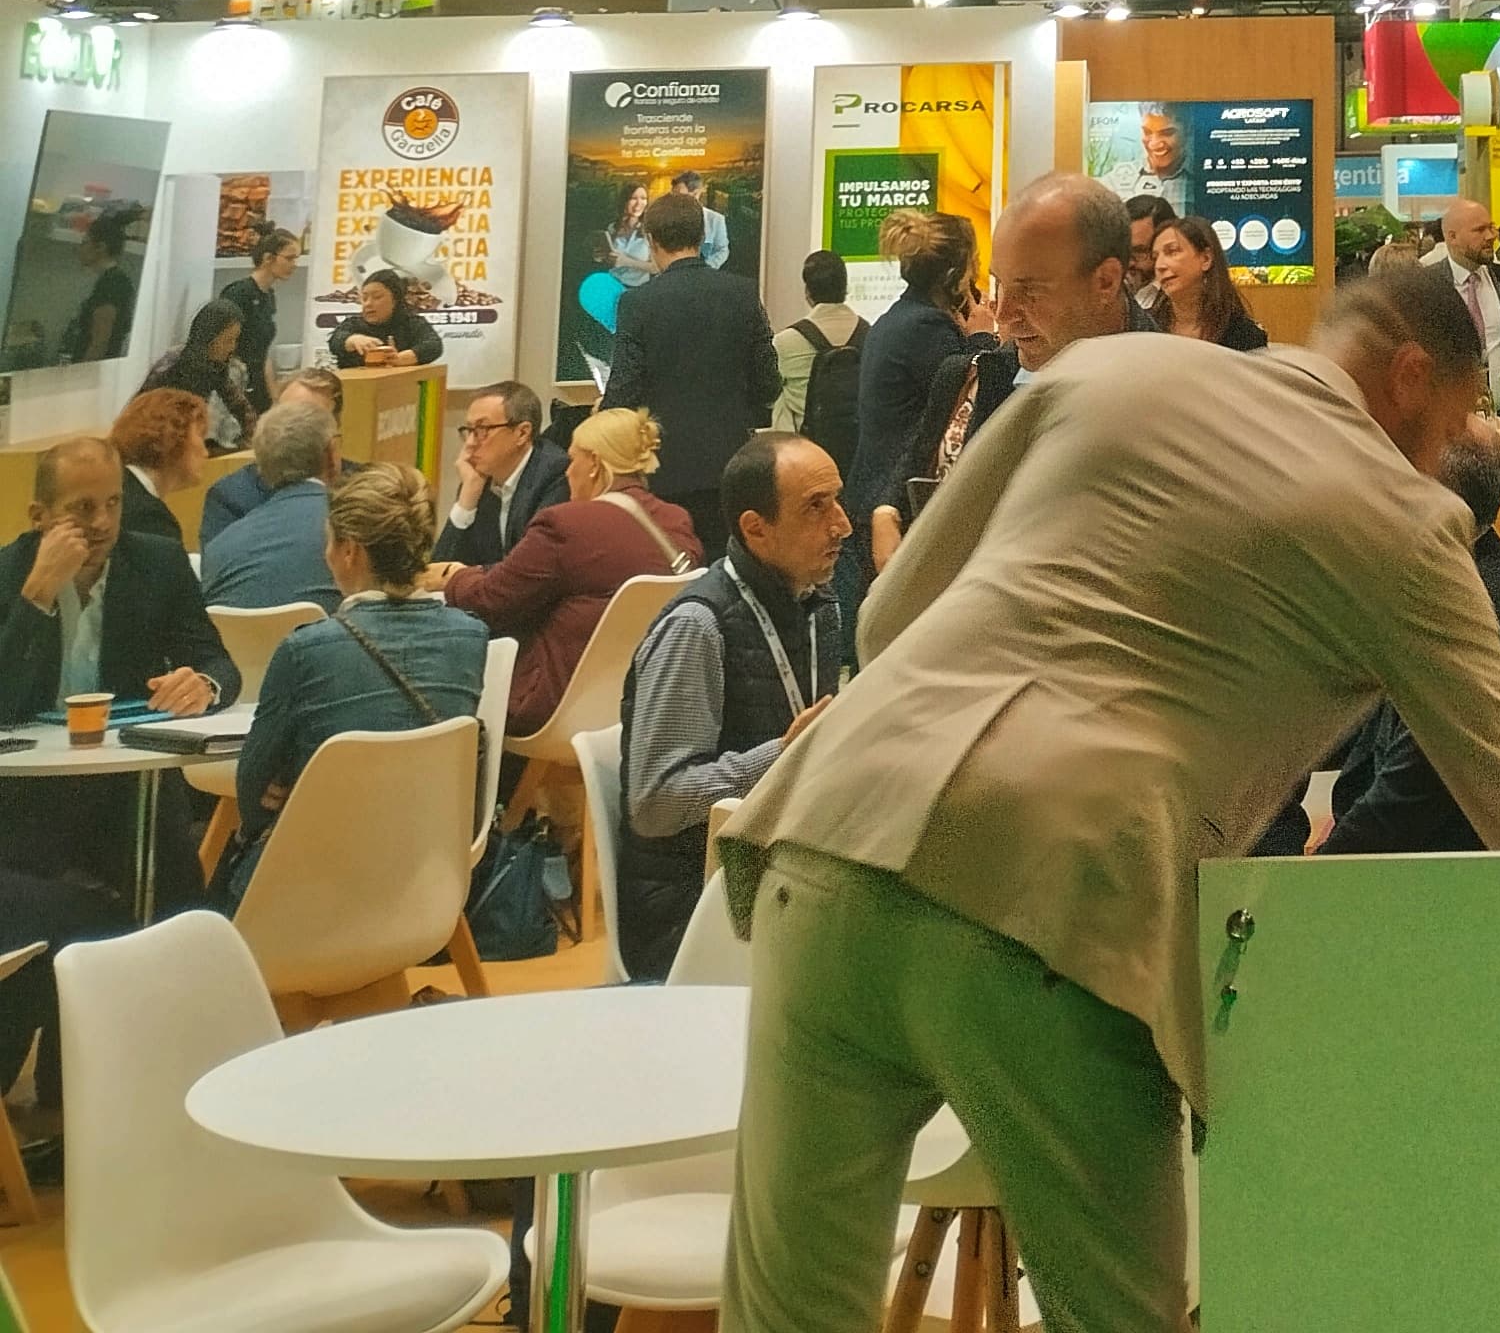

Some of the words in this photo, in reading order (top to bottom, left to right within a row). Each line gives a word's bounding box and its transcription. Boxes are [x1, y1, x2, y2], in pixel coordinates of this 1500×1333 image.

[633, 81, 720, 98] Confianza
[401, 94, 443, 111] Café
[637, 113, 694, 123] Trasciende
[671, 125, 693, 134] con
[391, 128, 450, 154] Gardella
[685, 137, 708, 147] que
[340, 166, 494, 190] EXPERIENCIA
[839, 179, 931, 193] IMPULSAMOS
[838, 194, 862, 207] TU
[866, 192, 930, 207] MARCA
